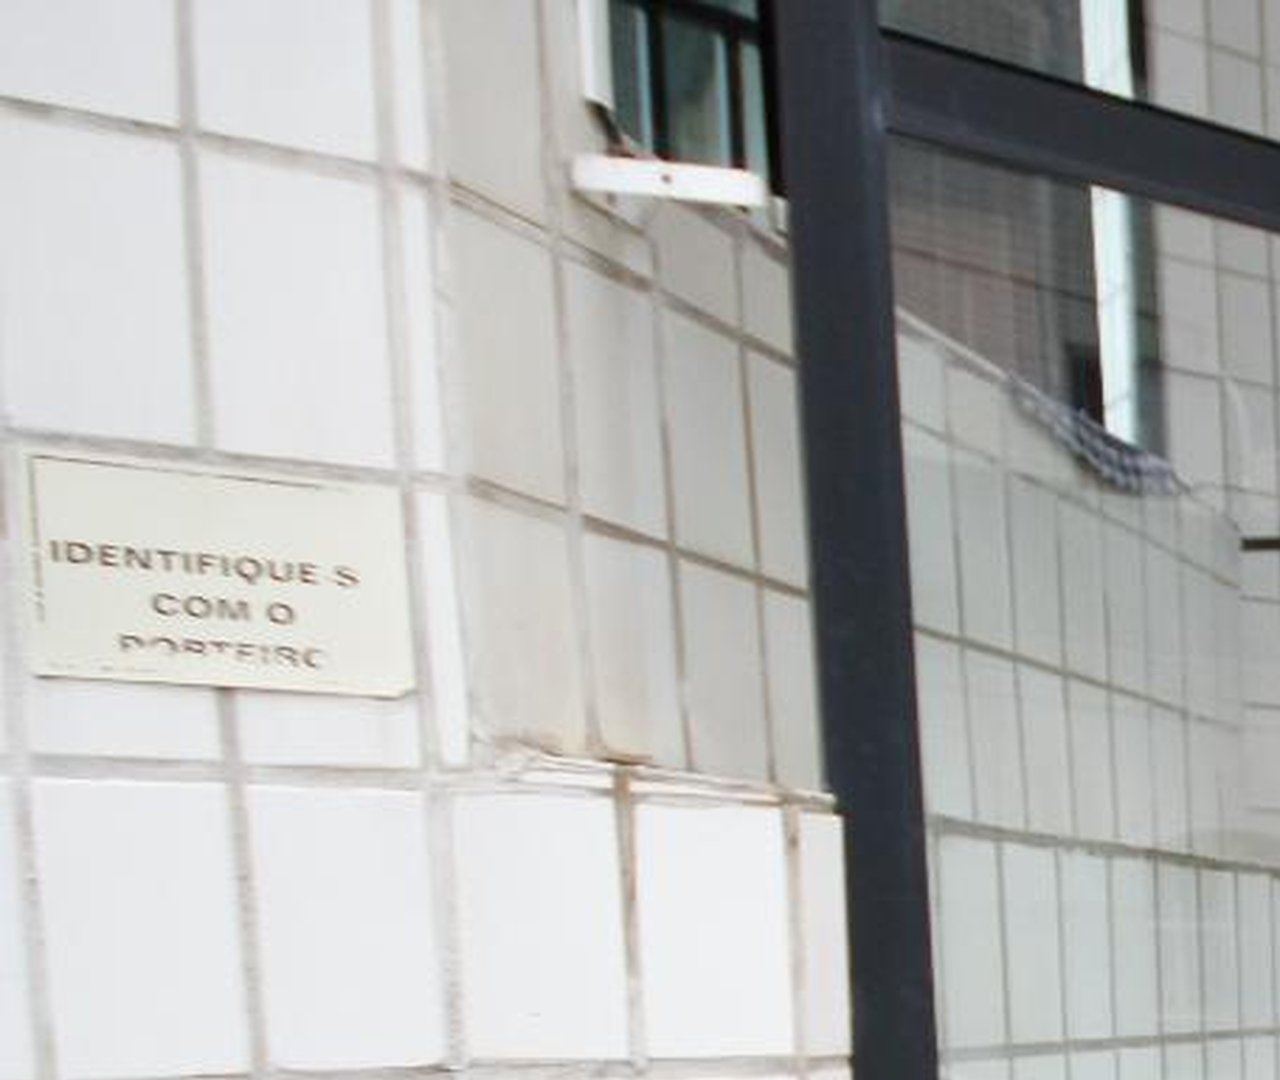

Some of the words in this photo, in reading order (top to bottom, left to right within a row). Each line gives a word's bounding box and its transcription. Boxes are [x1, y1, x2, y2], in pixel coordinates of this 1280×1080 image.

[48, 539, 319, 586] IDENTIFIQUE
[151, 592, 252, 622] COM
[266, 601, 297, 626] O
